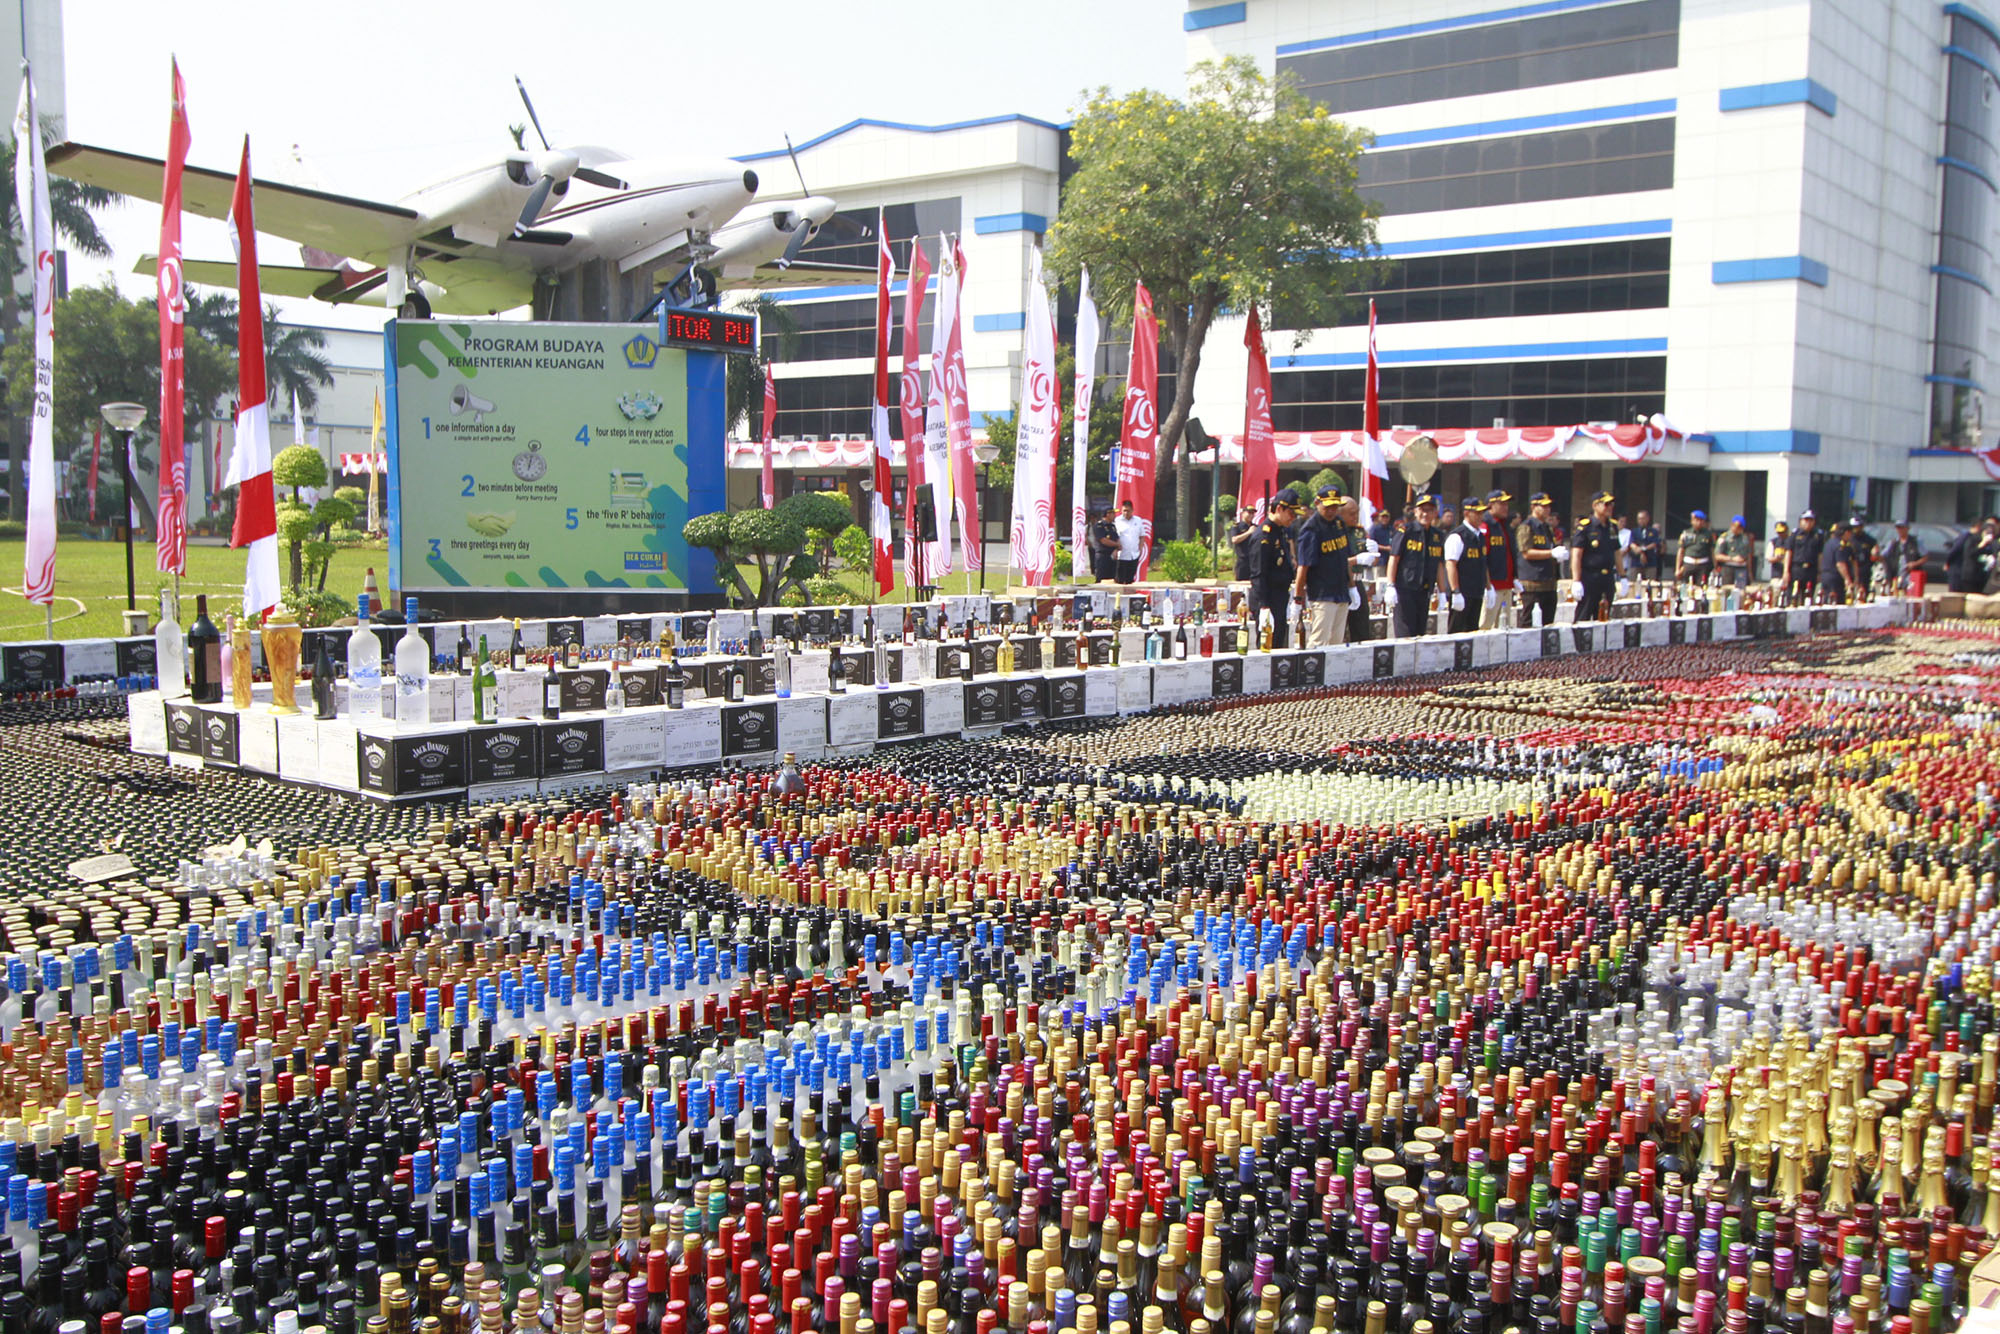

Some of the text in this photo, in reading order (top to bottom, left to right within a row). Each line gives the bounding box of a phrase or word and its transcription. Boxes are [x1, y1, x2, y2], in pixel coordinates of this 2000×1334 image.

[464, 338, 605, 353] PROGRAM BUDAYA
[448, 357, 604, 369] KEMENTERIAN KEUANGAN
[422, 417, 430, 439] 1
[436, 424, 449, 432] one
[451, 422, 494, 433] information
[502, 424, 516, 435] day
[575, 424, 591, 446] 4
[596, 427, 673, 438] four steps in every action
[461, 474, 475, 497] 2
[478, 483, 558, 494] two minutes before meeting
[565, 508, 579, 530] 5
[586, 510, 599, 519] the
[631, 510, 665, 520] behavior
[428, 538, 441, 560] 3
[451, 539, 530, 551] three greetings every day
[738, 710, 766, 724] JACK DANIEL'S
[485, 732, 521, 749] JACK DANIEL'S
[556, 728, 588, 744] JACK DANIEL'S
[412, 741, 449, 759] JACK DANIEL'S
